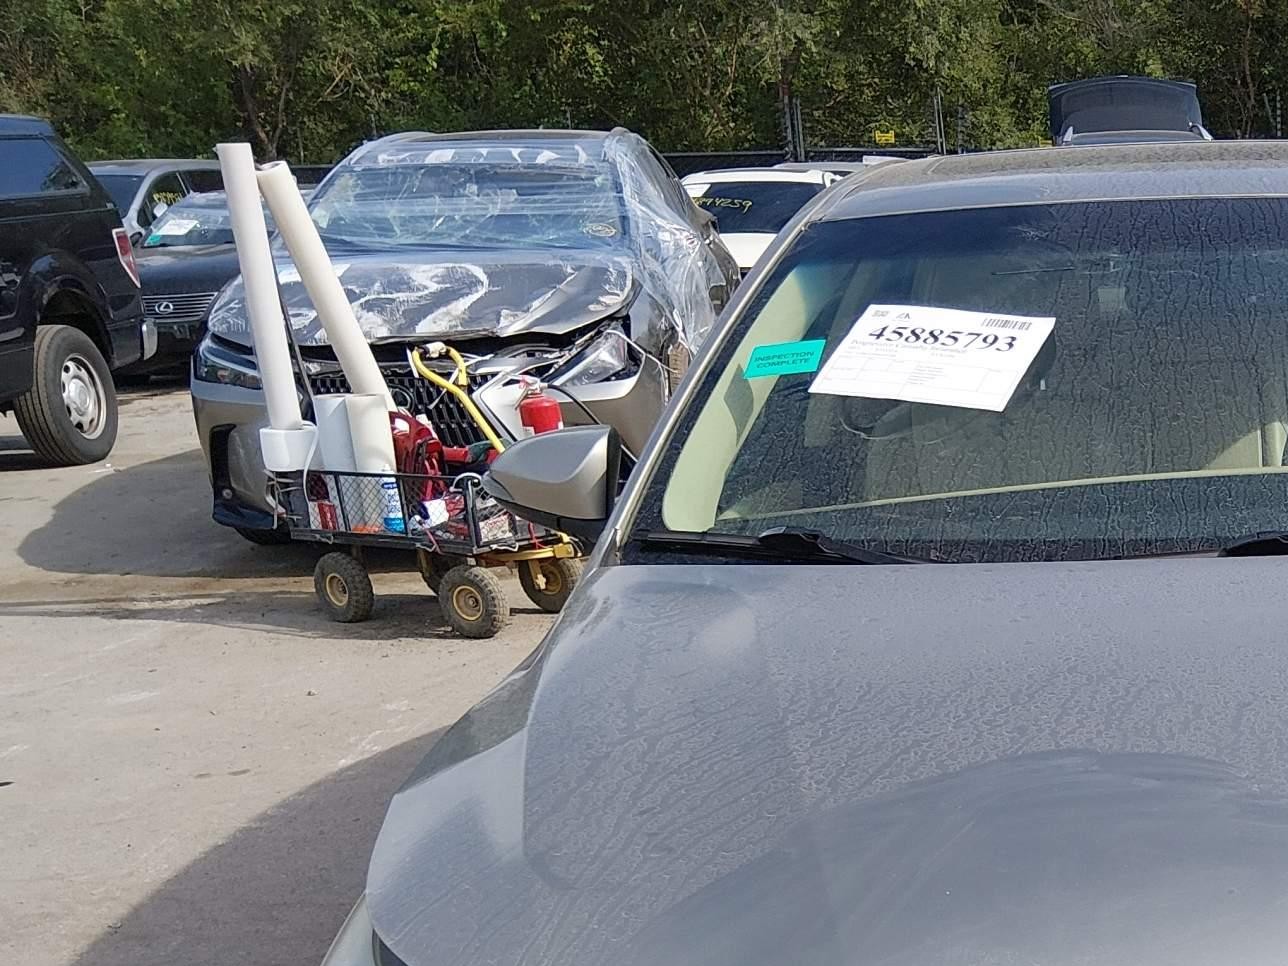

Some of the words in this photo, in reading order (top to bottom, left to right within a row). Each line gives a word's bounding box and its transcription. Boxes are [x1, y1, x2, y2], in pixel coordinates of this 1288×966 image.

[868, 325, 1018, 352] 45885793
[754, 352, 815, 363] INSPECTION
[756, 358, 811, 369] COMPLETE
